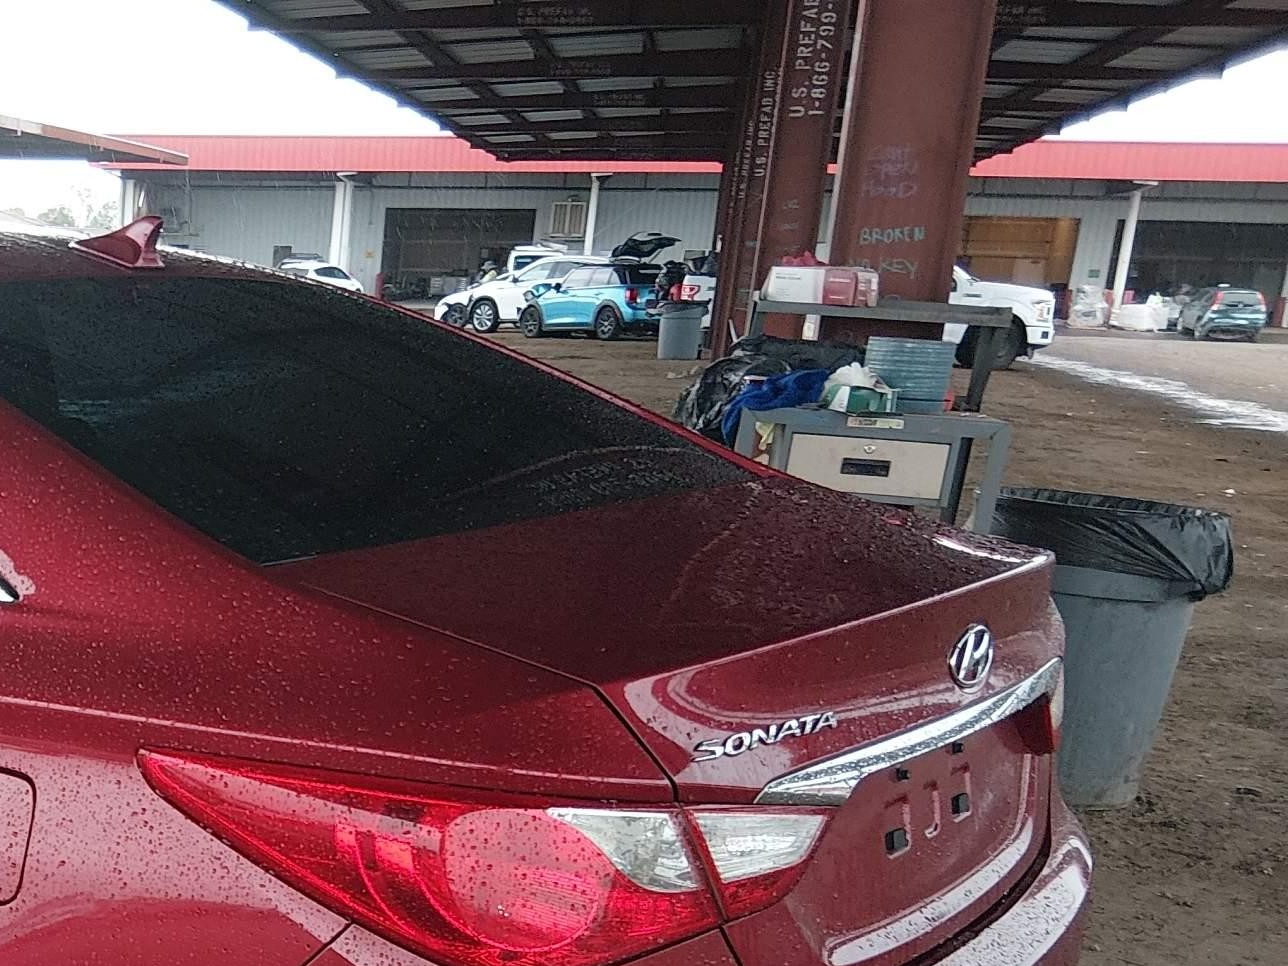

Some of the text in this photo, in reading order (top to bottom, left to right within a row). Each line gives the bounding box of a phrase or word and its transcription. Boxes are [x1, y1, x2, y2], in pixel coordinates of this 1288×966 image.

[788, 81, 810, 117] U.S.
[859, 227, 925, 246] BROKEN
[879, 257, 918, 279] KEY
[691, 711, 837, 763] SONATA
